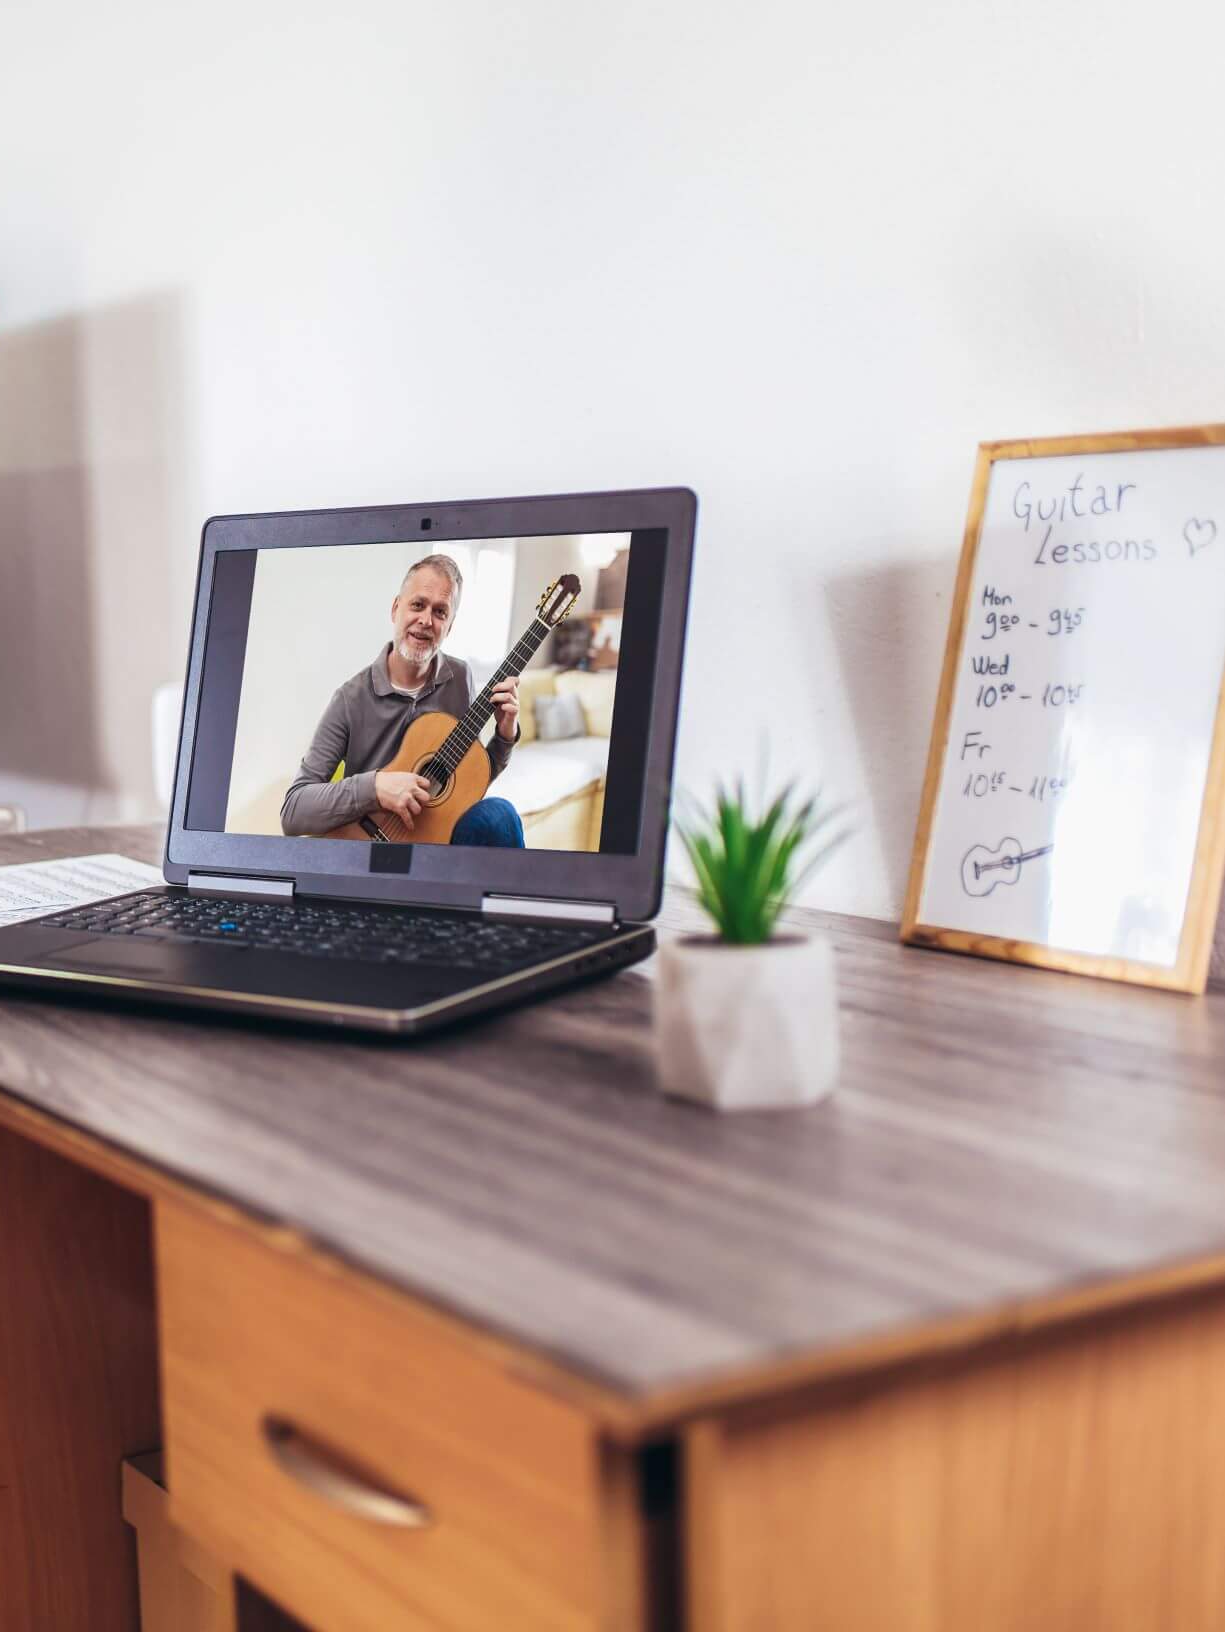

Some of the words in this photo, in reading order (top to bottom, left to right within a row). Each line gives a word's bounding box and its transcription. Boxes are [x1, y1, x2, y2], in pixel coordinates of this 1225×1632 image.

[1013, 473, 1136, 531] Guitar
[1034, 525, 1157, 565] Lessons
[981, 585, 1012, 606] Mon
[972, 654, 1009, 676] Wed
[961, 731, 992, 760] Fr
